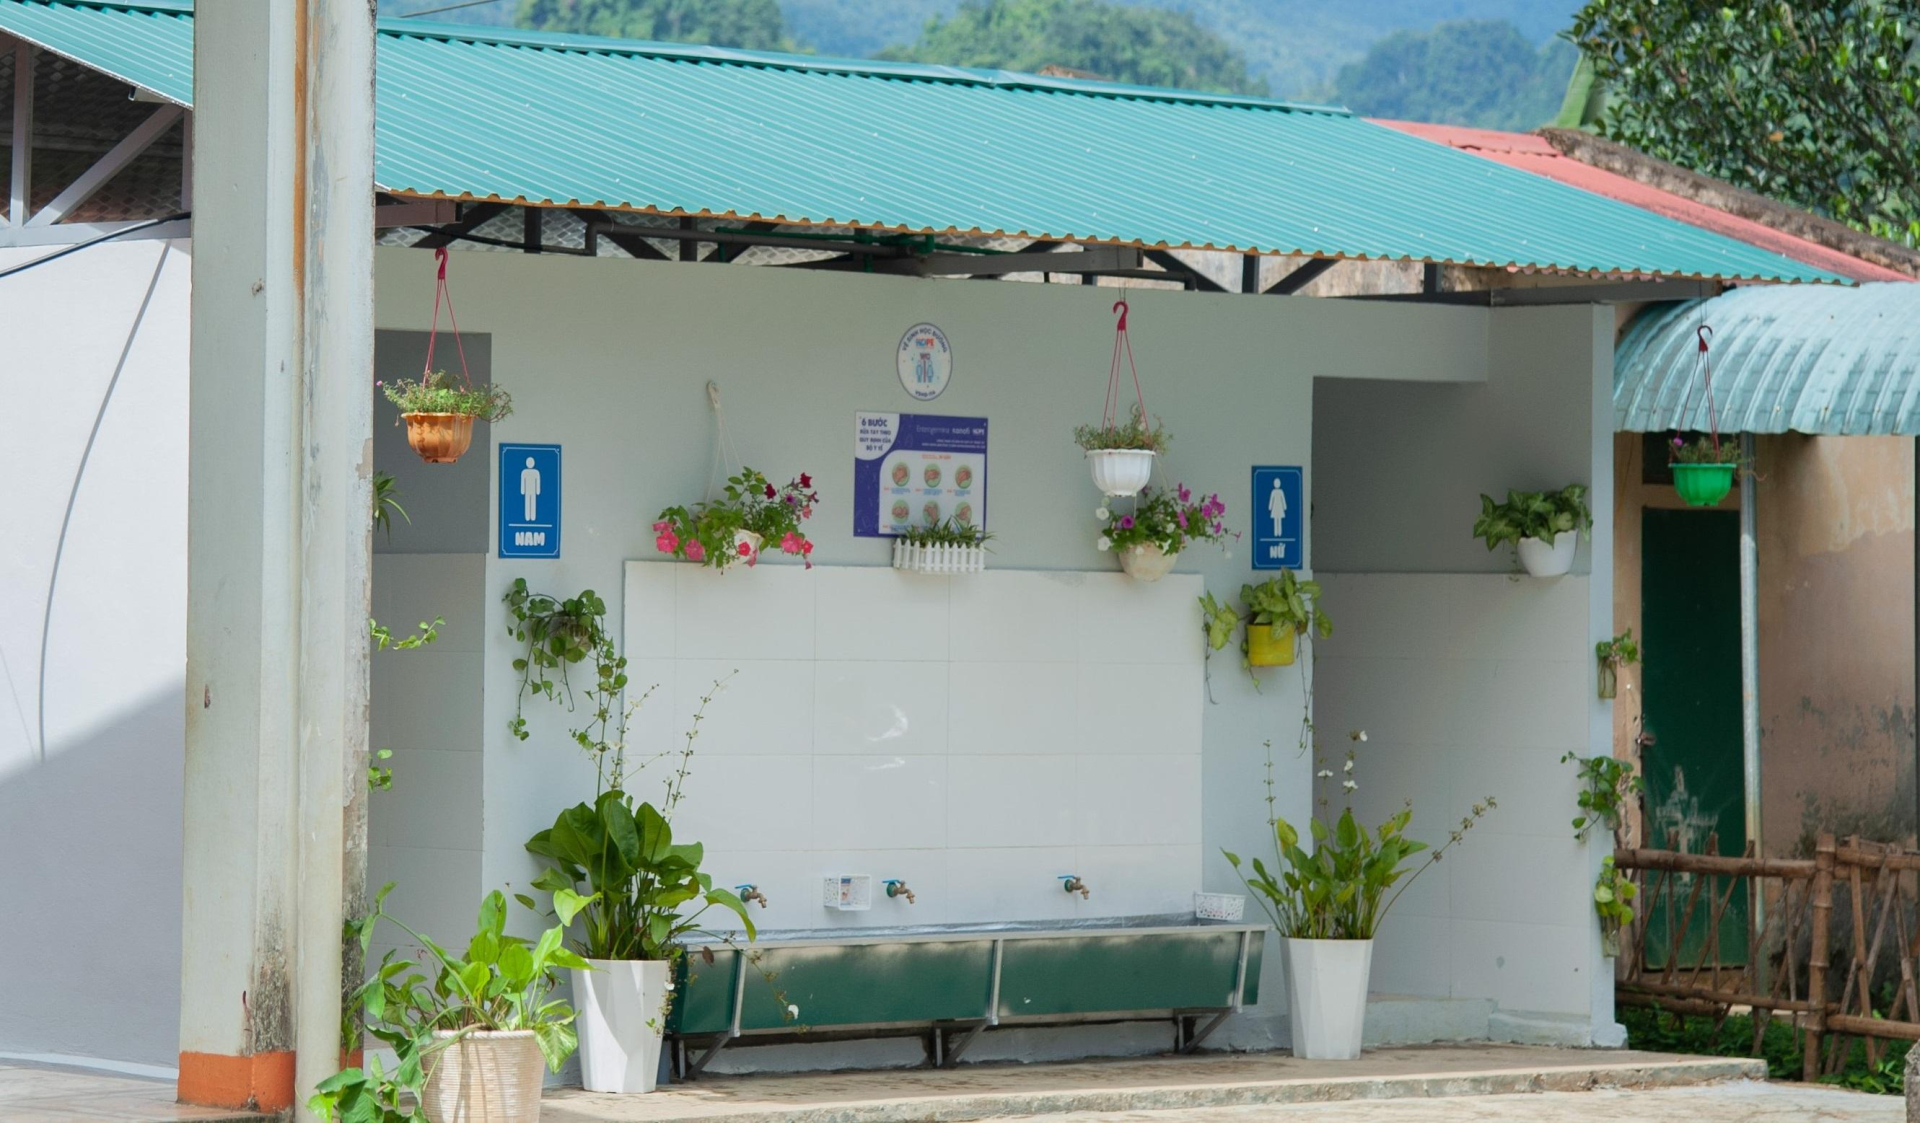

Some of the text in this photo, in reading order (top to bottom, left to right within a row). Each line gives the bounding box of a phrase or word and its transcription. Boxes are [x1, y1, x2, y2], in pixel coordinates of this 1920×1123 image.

[861, 416, 888, 427] 6 BƯỚC
[515, 532, 546, 546] NAM
[1270, 542, 1286, 559] NỮ
